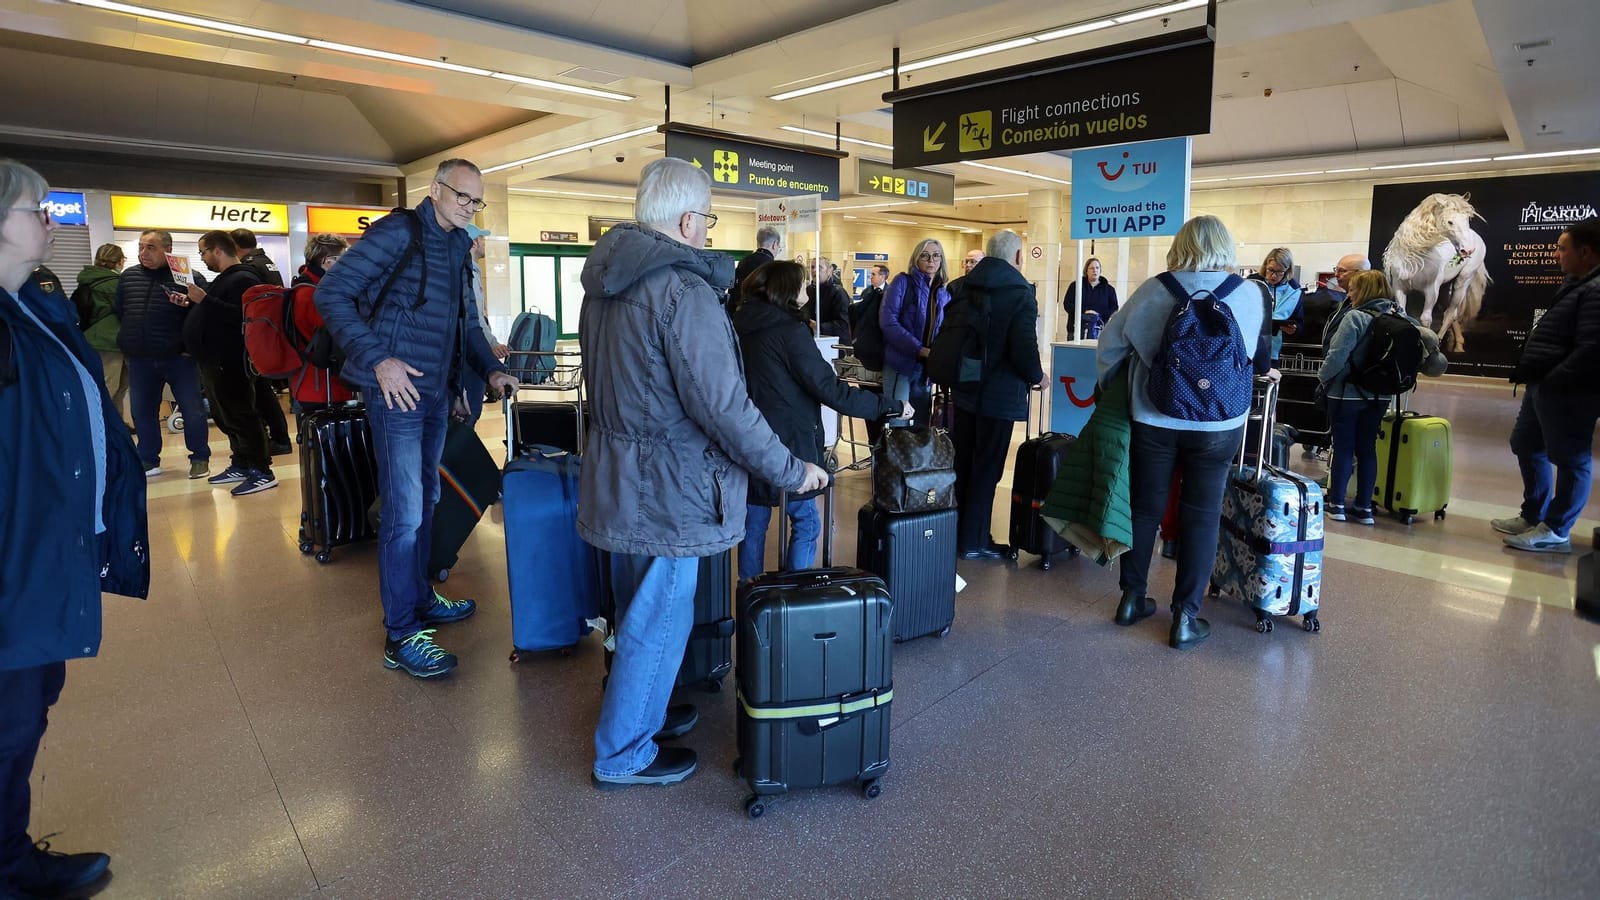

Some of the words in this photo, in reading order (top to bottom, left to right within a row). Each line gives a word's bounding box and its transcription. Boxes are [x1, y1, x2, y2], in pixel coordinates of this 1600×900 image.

[1001, 103, 1040, 125] Flight
[1045, 91, 1141, 117] connections
[1001, 119, 1080, 146] Conexión
[1086, 111, 1148, 136] vuelos
[748, 157, 776, 172] Meeting
[777, 161, 795, 173] point
[1132, 161, 1157, 176] TUI
[748, 173, 775, 187] Punto
[777, 176, 788, 188] de
[789, 180, 829, 194] encuentro
[210, 205, 272, 224] Hertz
[1086, 202, 1143, 215] Download
[1146, 200, 1167, 212] the
[1542, 207, 1598, 219] CARTUJA
[758, 213, 786, 222] Sidetours
[1085, 218, 1118, 234] TUI
[1123, 214, 1167, 233] APP
[1515, 242, 1545, 250] ÚNICO
